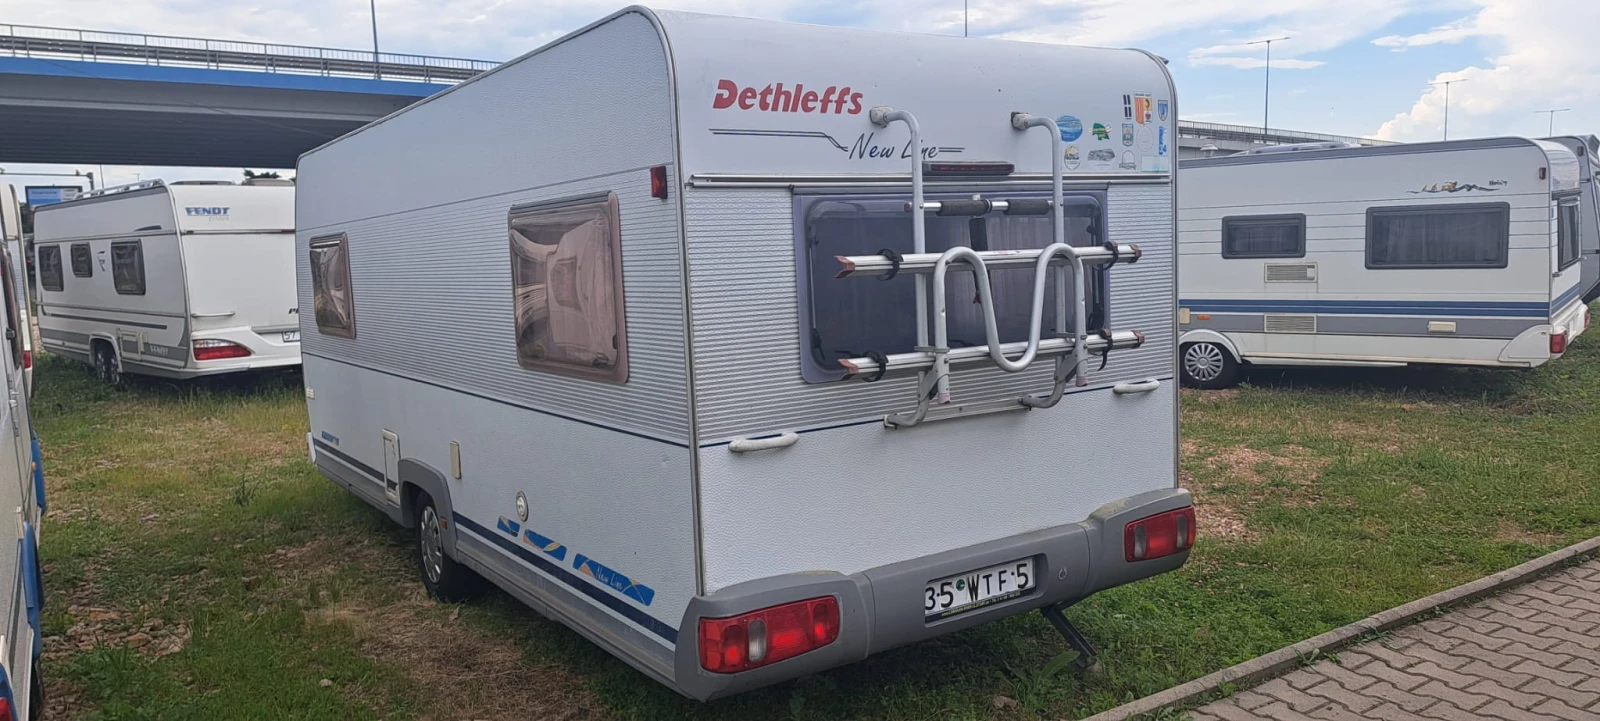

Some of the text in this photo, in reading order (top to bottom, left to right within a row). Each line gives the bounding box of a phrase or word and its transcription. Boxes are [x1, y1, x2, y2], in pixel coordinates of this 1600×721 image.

[712, 79, 864, 115] Dethleffs
[848, 132, 938, 160] New Lne
[184, 207, 230, 215] FENDT
